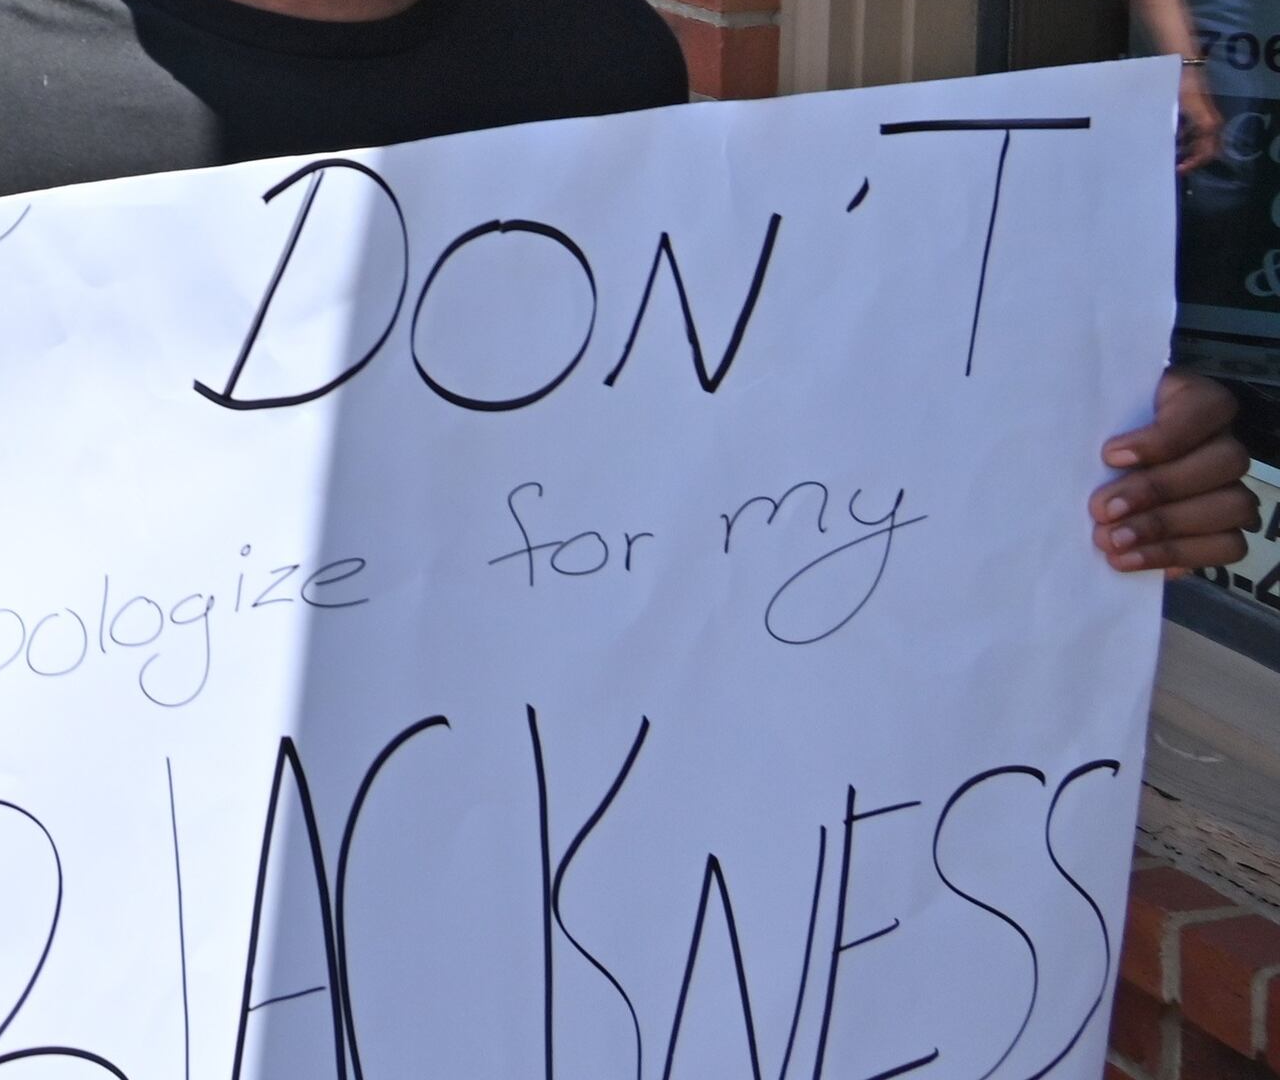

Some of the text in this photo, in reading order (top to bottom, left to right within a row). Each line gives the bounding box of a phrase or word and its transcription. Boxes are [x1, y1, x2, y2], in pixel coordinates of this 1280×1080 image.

[192, 117, 1094, 413] DON'T
[488, 480, 656, 590] for
[721, 477, 930, 647] my
